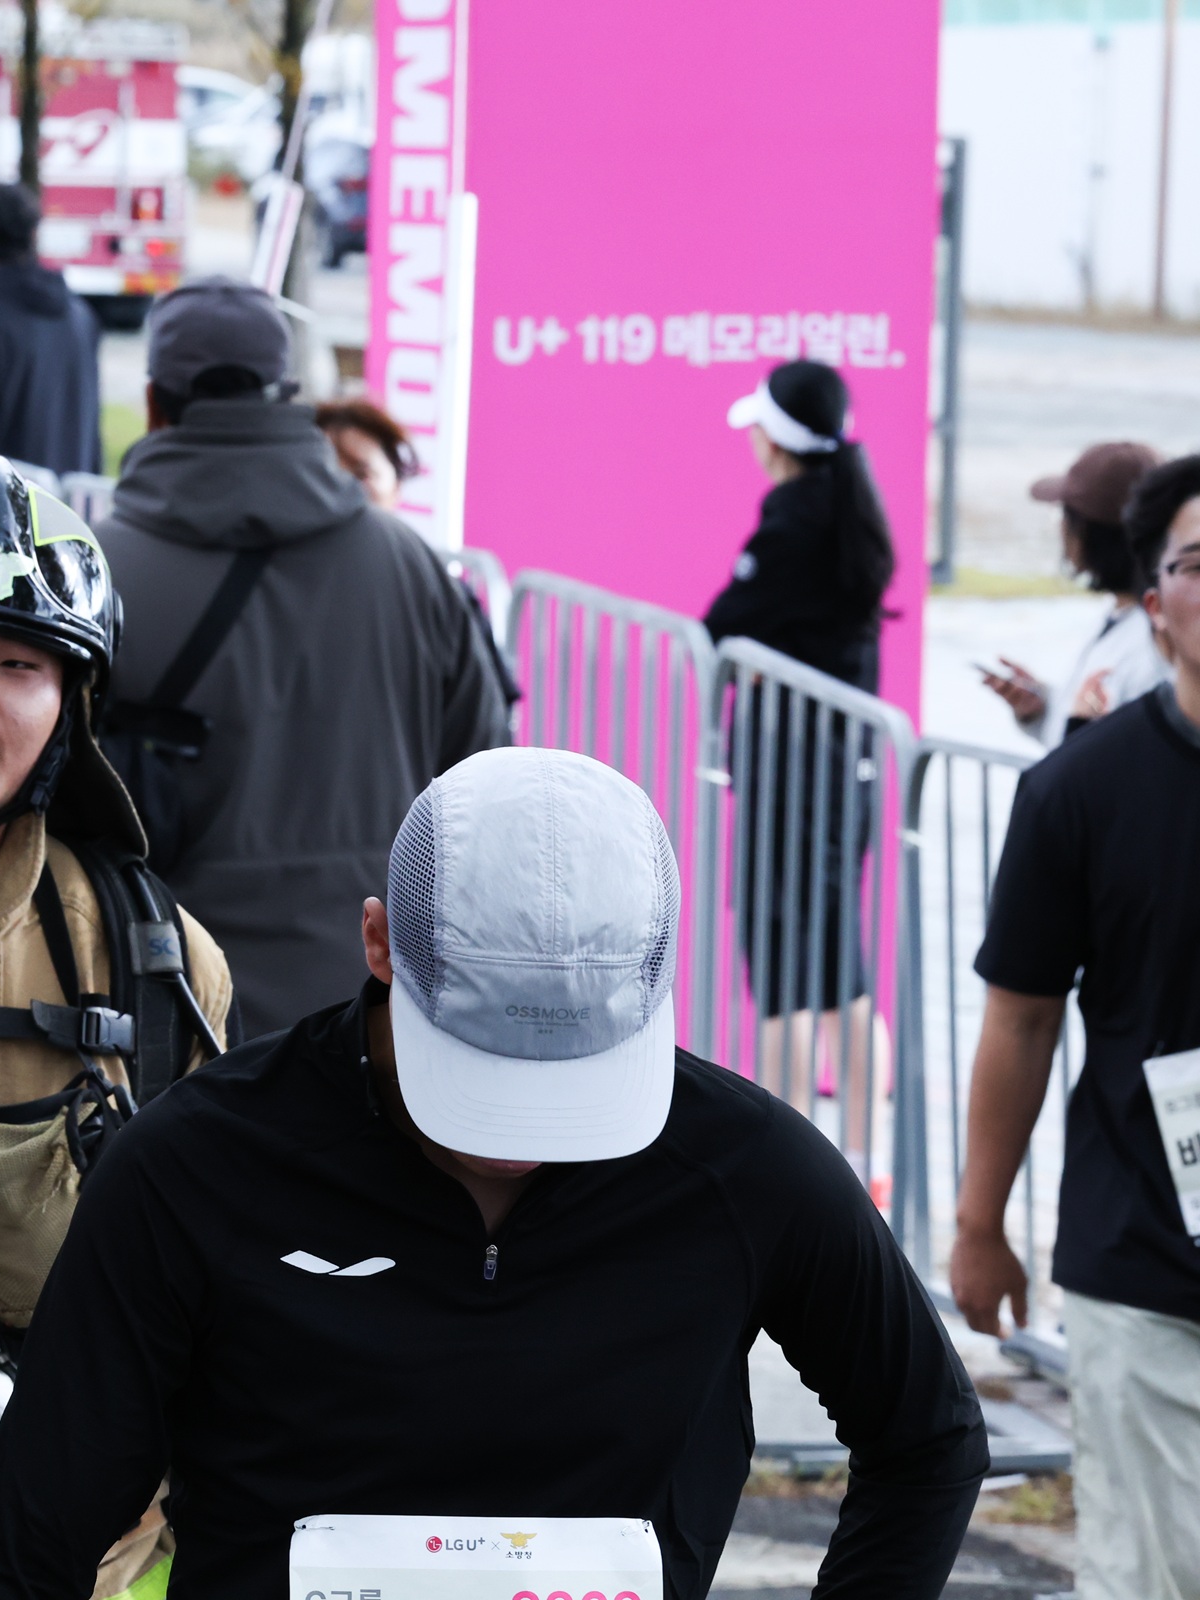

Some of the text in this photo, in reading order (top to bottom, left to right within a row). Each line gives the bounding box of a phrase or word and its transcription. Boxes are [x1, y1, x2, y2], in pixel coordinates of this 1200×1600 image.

[493, 309, 907, 369] U+ 119 메모리얼런.
[505, 1005, 591, 1020] OSSMOVE
[445, 1539, 463, 1551] LG
[505, 1551, 532, 1560] 소방청
